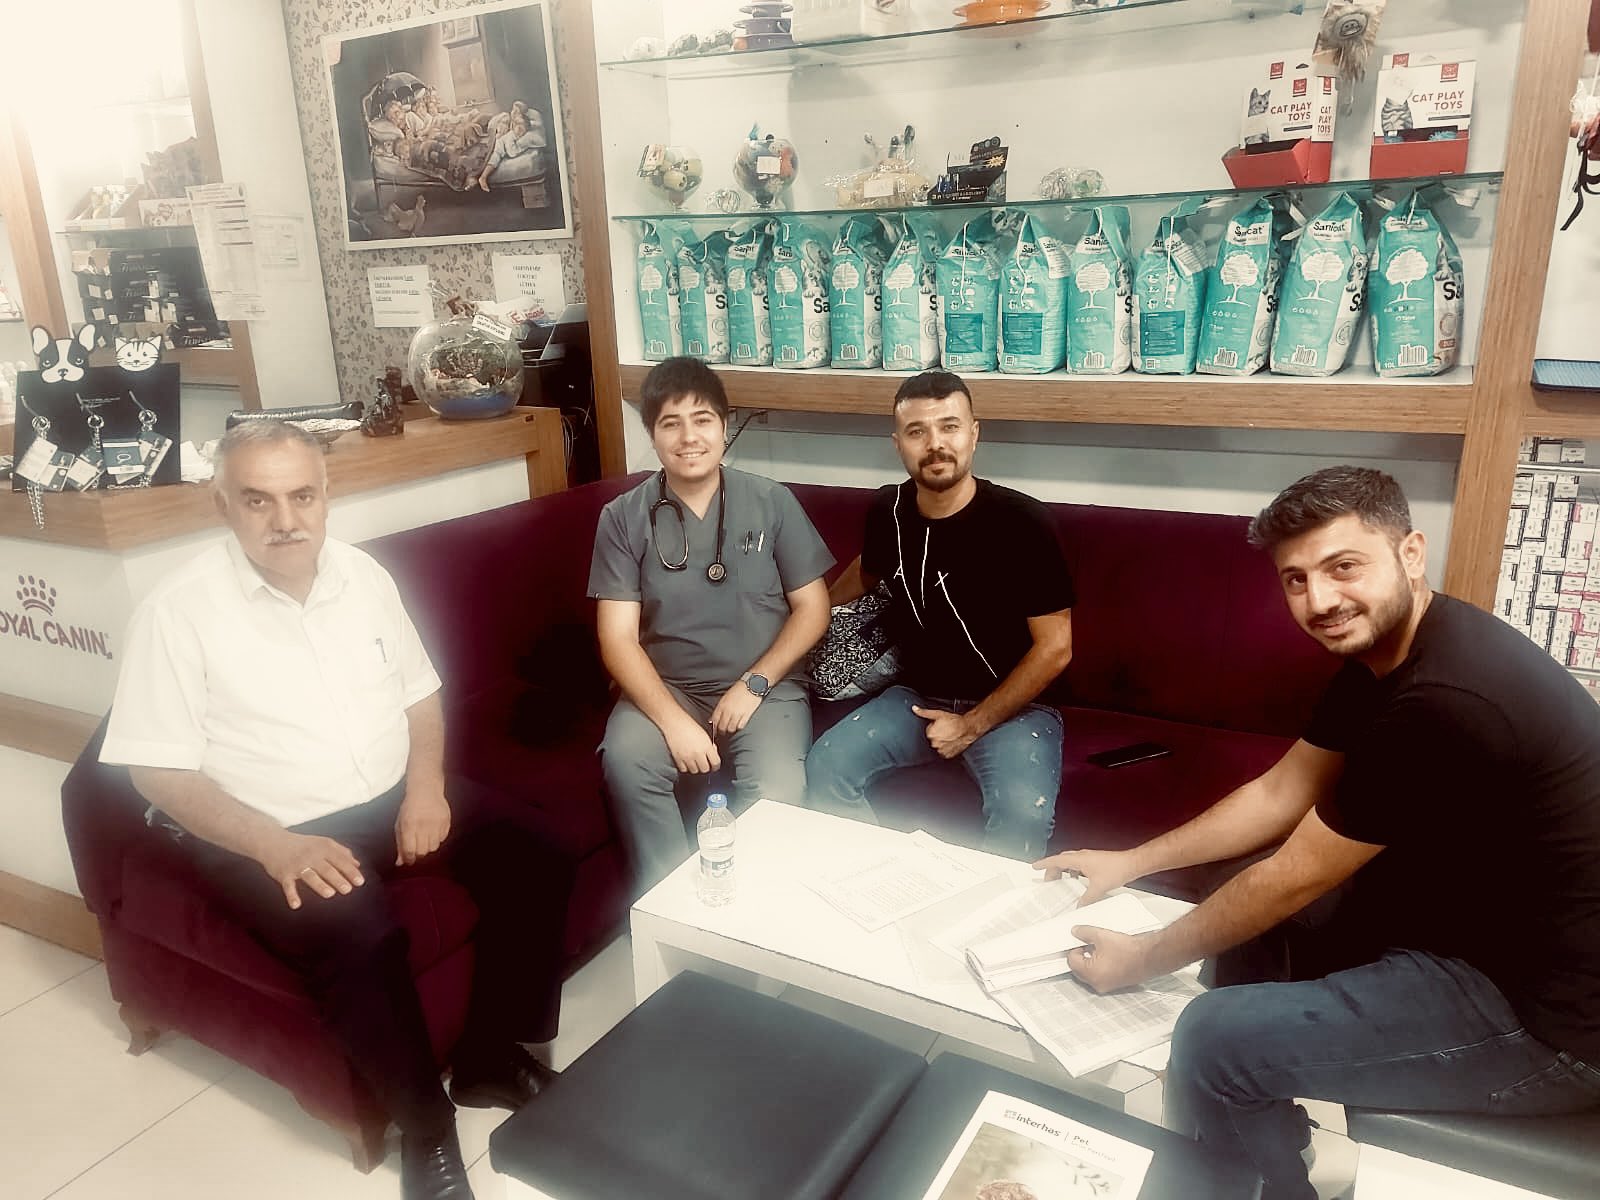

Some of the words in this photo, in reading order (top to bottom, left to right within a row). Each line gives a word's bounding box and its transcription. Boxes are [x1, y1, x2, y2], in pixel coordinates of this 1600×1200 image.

[1411, 93, 1434, 103] CAT
[1437, 90, 1464, 101] PLAY
[1270, 105, 1288, 115] CAT
[1290, 102, 1312, 112] PLAY
[1320, 106, 1331, 114] CAT
[1434, 100, 1464, 111] TOYS
[1288, 111, 1311, 121] TOYS
[1318, 115, 1332, 124] PLAY
[1317, 125, 1331, 133] TOYS
[1073, 1135, 1090, 1146] Pet
